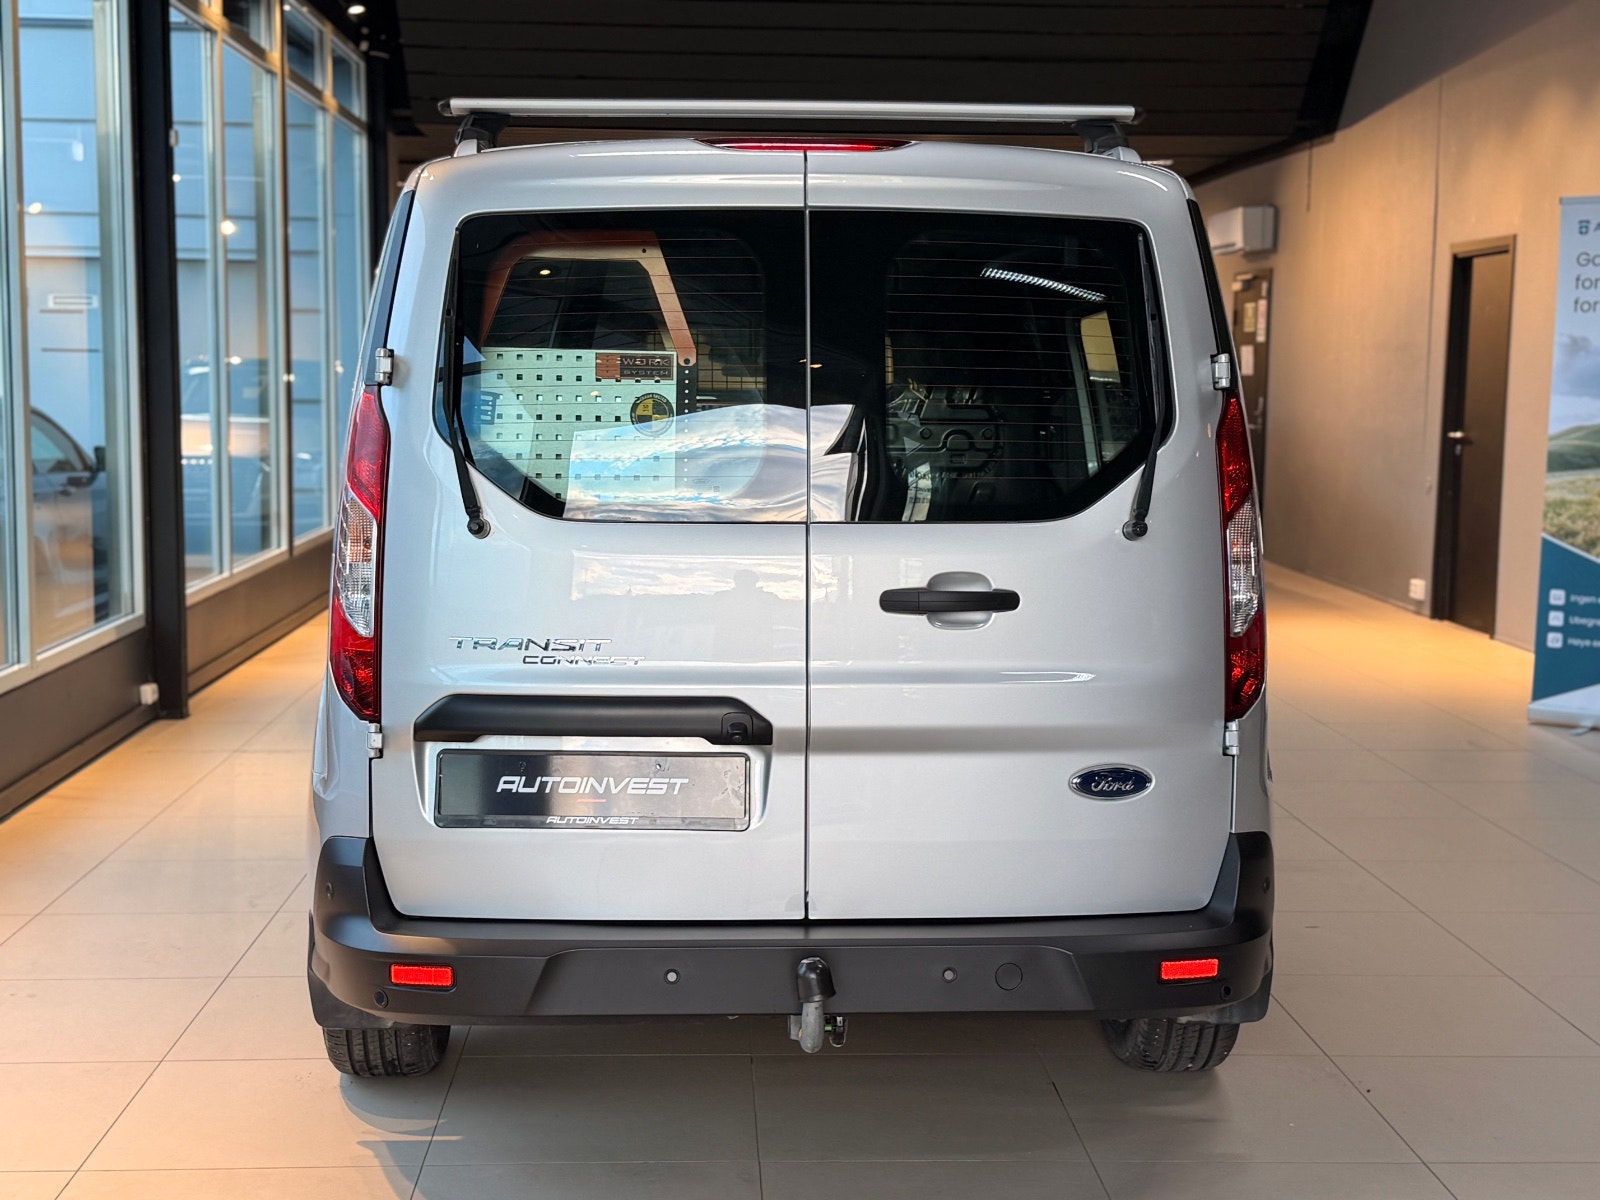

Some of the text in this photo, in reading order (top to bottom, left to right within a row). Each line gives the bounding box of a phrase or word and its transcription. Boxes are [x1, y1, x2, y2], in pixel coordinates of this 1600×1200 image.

[622, 358, 669, 366] WORK
[448, 636, 613, 652] TRANSIT
[522, 655, 646, 666] CONNECT
[496, 775, 689, 795] AUTOINVEST
[1091, 773, 1135, 792] Ford
[546, 816, 640, 826] AUTOINVEST
